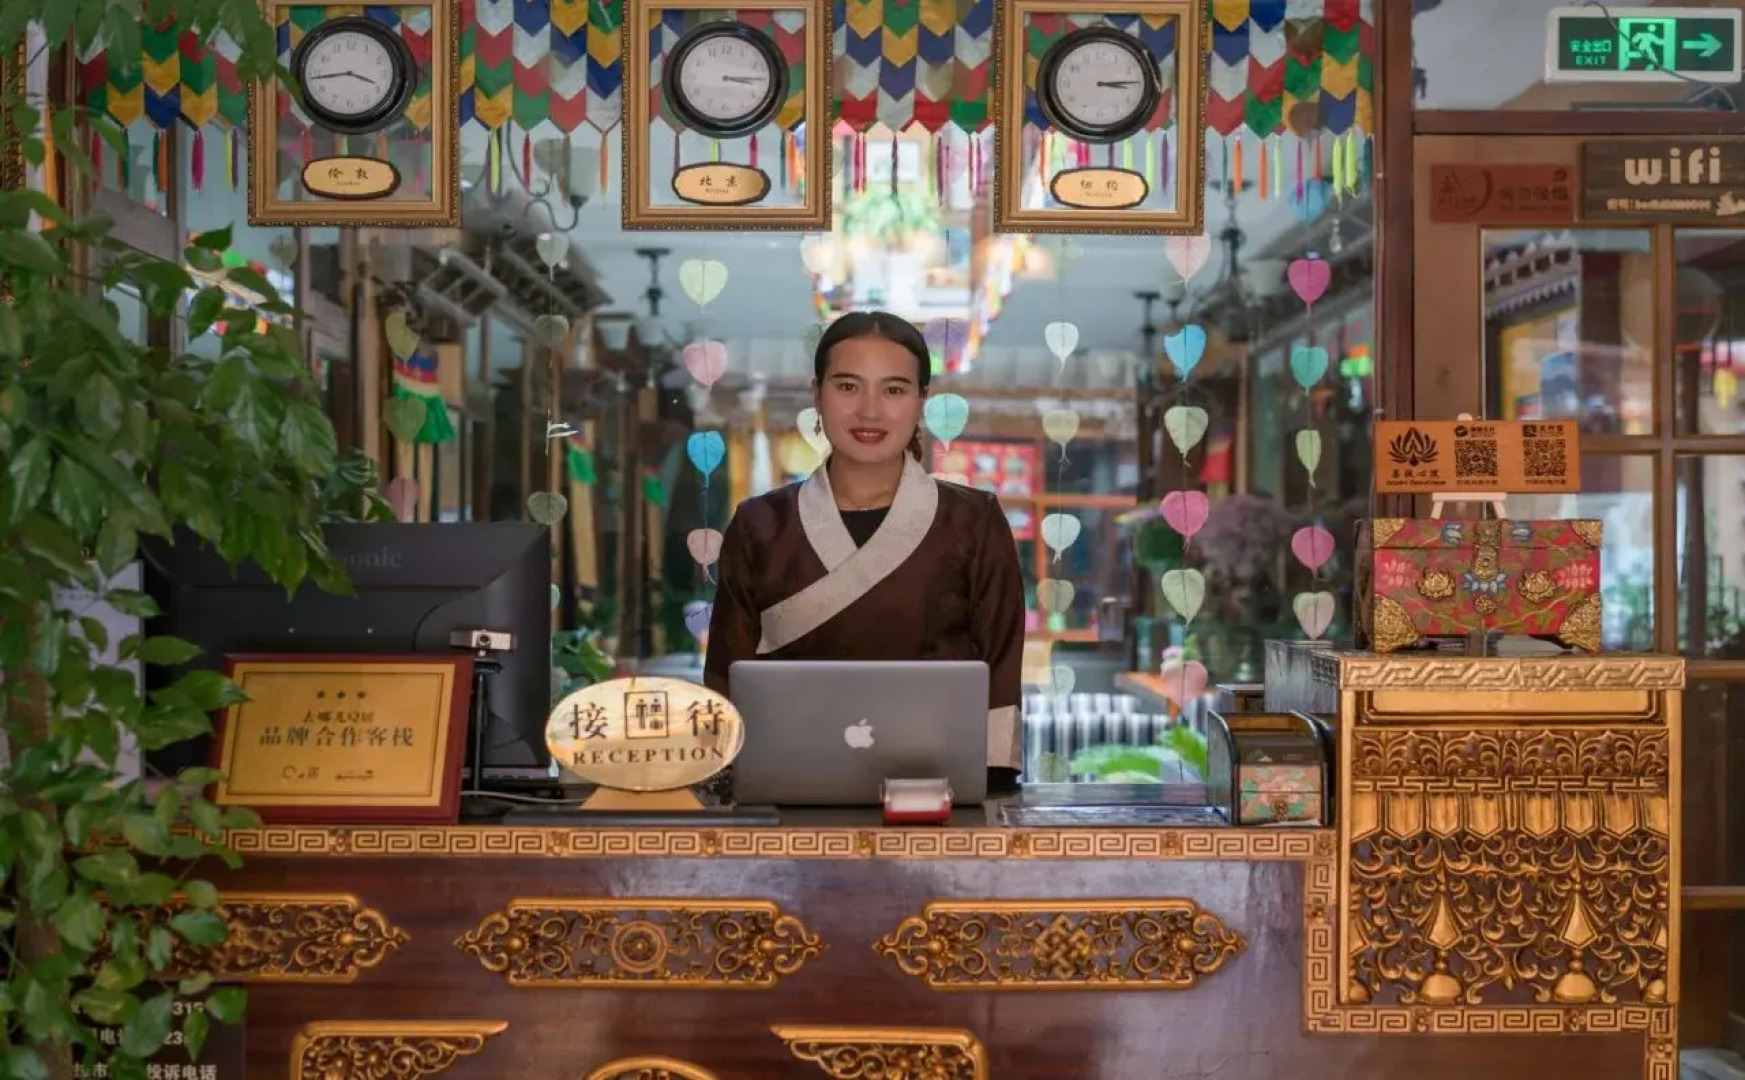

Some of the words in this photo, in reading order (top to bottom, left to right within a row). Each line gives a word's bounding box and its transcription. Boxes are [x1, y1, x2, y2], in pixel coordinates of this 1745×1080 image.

[1570, 39, 1612, 53] 安全出口
[1575, 55, 1607, 65] EXIT
[1624, 146, 1721, 185] wifi
[569, 702, 609, 741] 接
[686, 698, 726, 737] 待
[259, 725, 414, 747] 品牌合作客栈
[572, 745, 724, 766] RECEPTION
[146, 1063, 218, 1080] 投诉电话
